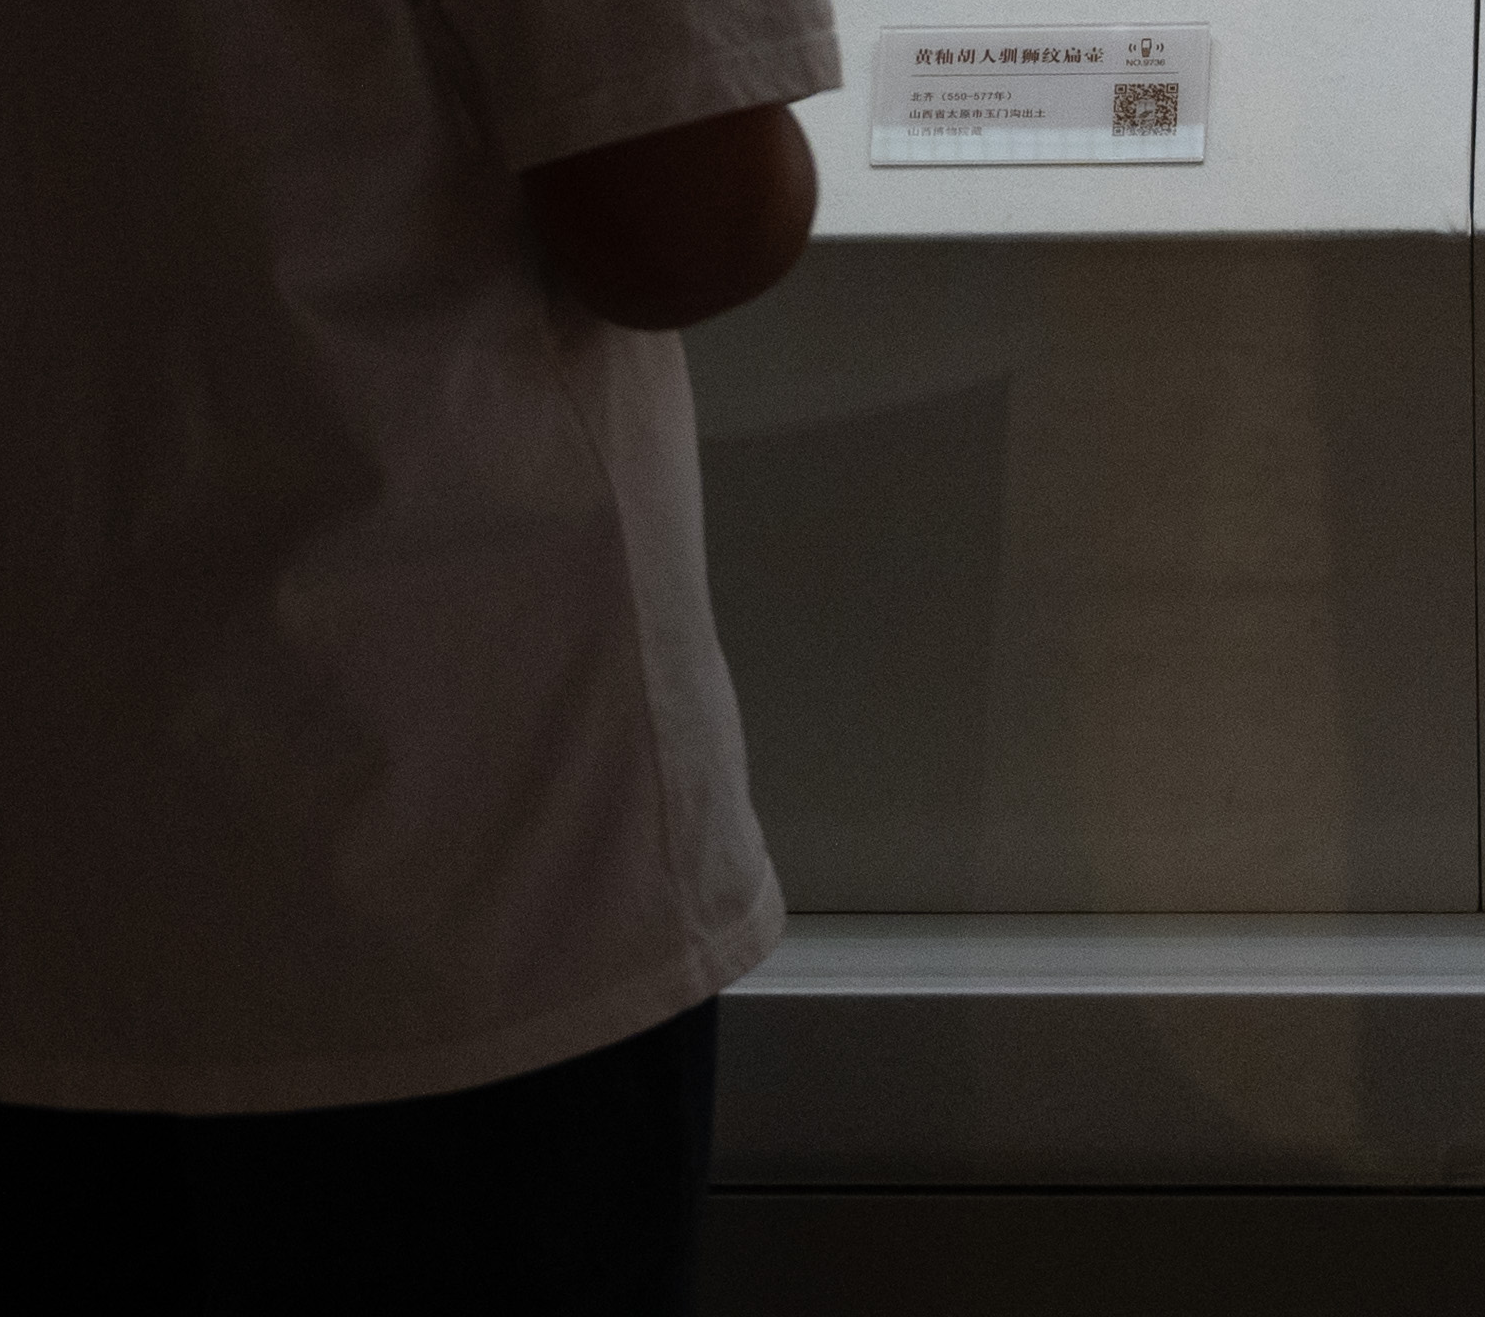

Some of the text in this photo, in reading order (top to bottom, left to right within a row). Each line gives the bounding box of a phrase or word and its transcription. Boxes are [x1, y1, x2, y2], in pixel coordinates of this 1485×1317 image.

[914, 46, 1105, 66] 黄釉胡人驯狮纹扁壶
